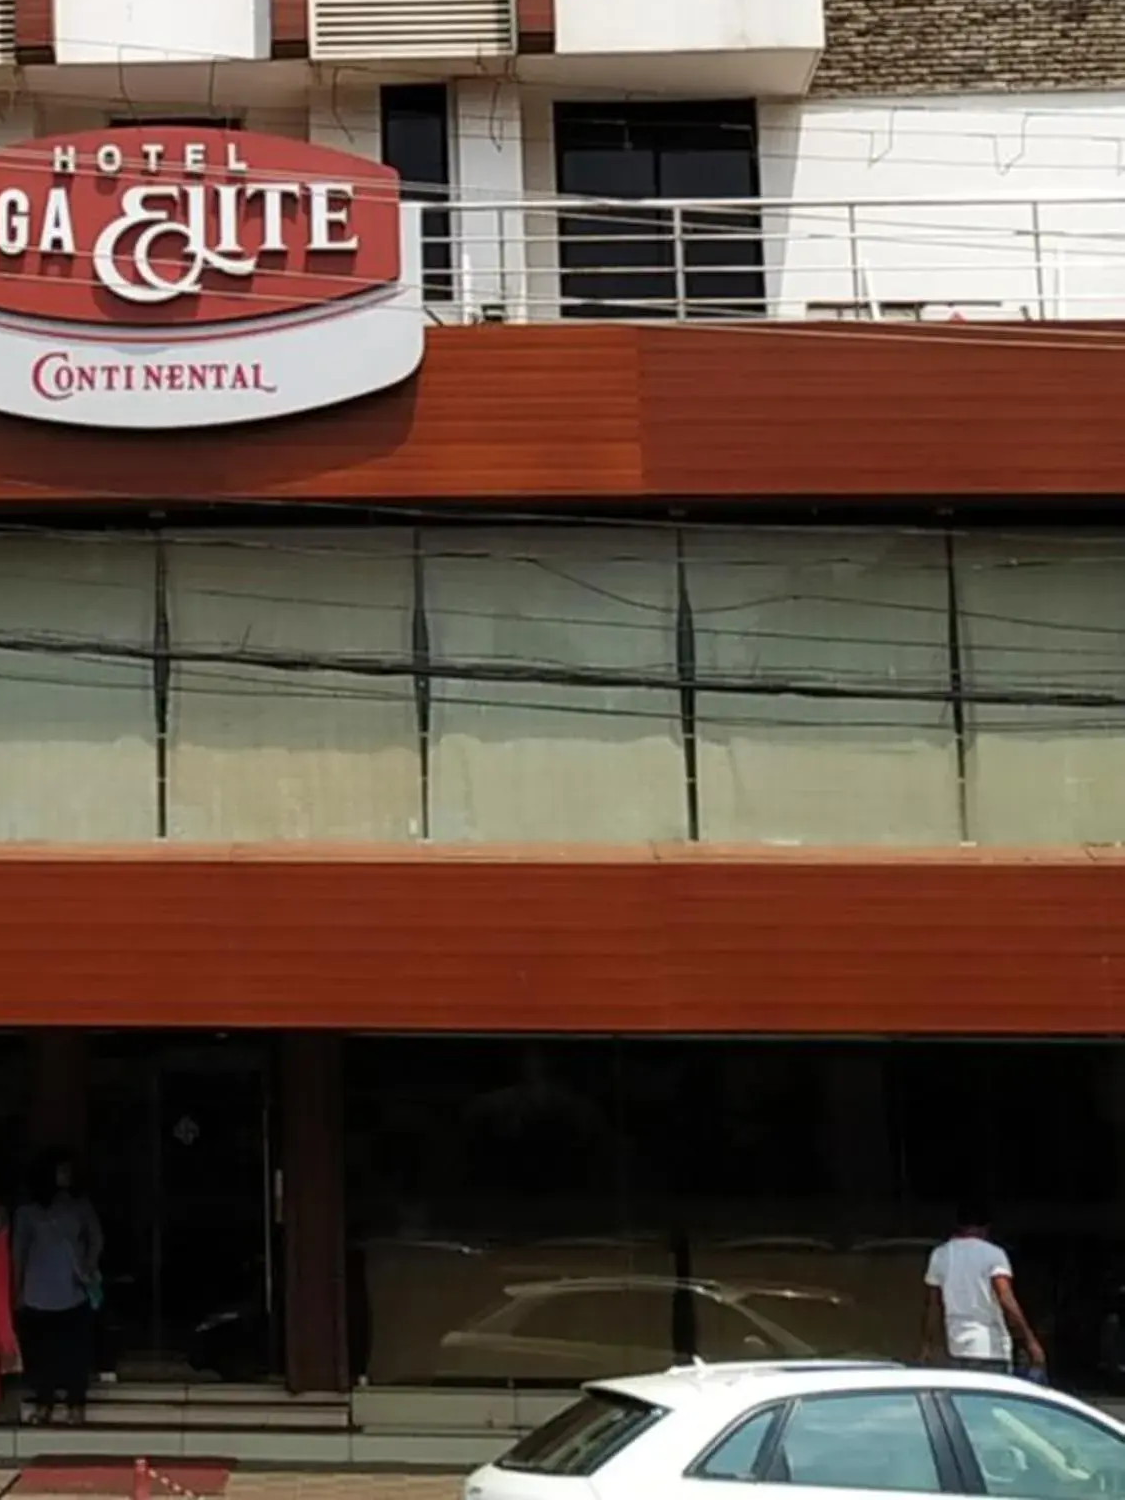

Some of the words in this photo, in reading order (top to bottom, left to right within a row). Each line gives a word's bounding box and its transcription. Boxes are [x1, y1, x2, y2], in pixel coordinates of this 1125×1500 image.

[53, 142, 248, 175] HOTEL
[92, 181, 359, 302] ELITE
[31, 351, 277, 400] CONTINENTAL
